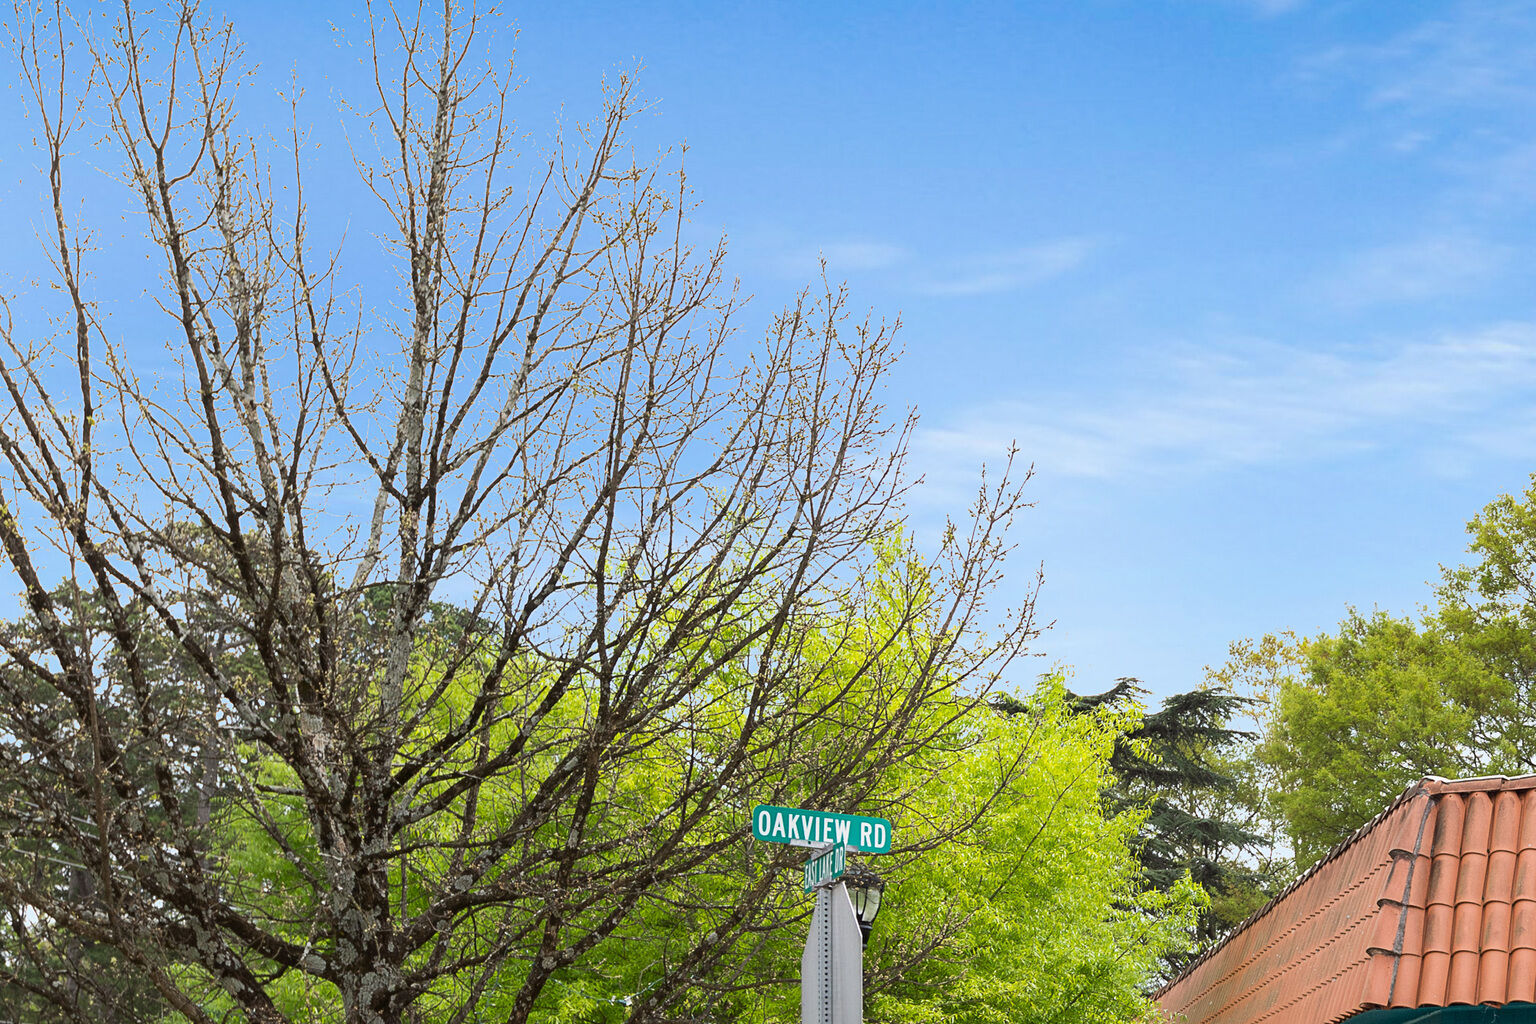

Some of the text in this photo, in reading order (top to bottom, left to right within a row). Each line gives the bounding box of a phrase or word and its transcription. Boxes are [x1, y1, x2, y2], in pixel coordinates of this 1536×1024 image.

[758, 810, 886, 848] OAKVIEW RD
[805, 846, 844, 890] EAST LAKE DR
